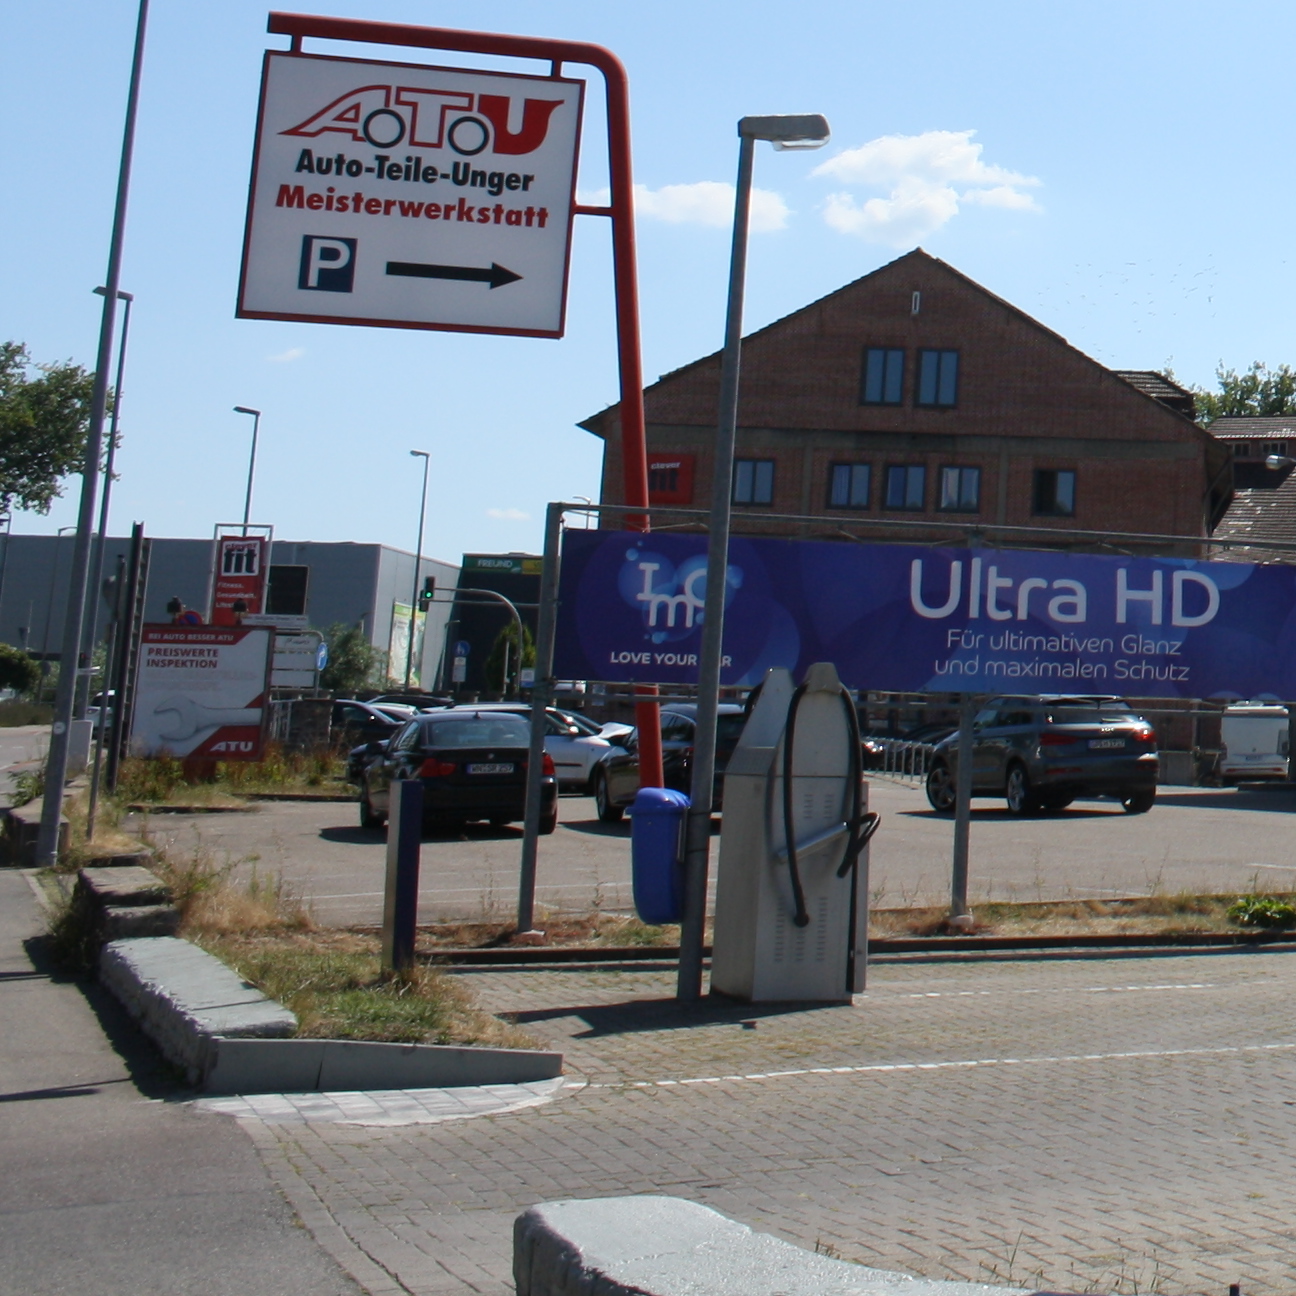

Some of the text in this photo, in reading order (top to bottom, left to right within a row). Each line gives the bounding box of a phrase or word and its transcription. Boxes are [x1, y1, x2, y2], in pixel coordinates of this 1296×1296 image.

[276, 84, 565, 156] ATU
[295, 148, 535, 197] Auto-Teile-Unger
[275, 184, 549, 229] Meisterwerkstatt
[306, 238, 352, 287] P
[910, 556, 1088, 624] Ultra
[1116, 567, 1221, 628] HD
[163, 633, 186, 641] AUTO
[946, 627, 1182, 657] Für ultimativen Glanz
[146, 658, 218, 669] INSPEKTION
[147, 647, 219, 658] PREISWERTE
[610, 651, 698, 666] LOVE YOUR
[935, 655, 1191, 682] und maximalen Schutz
[209, 741, 254, 752] ATU
